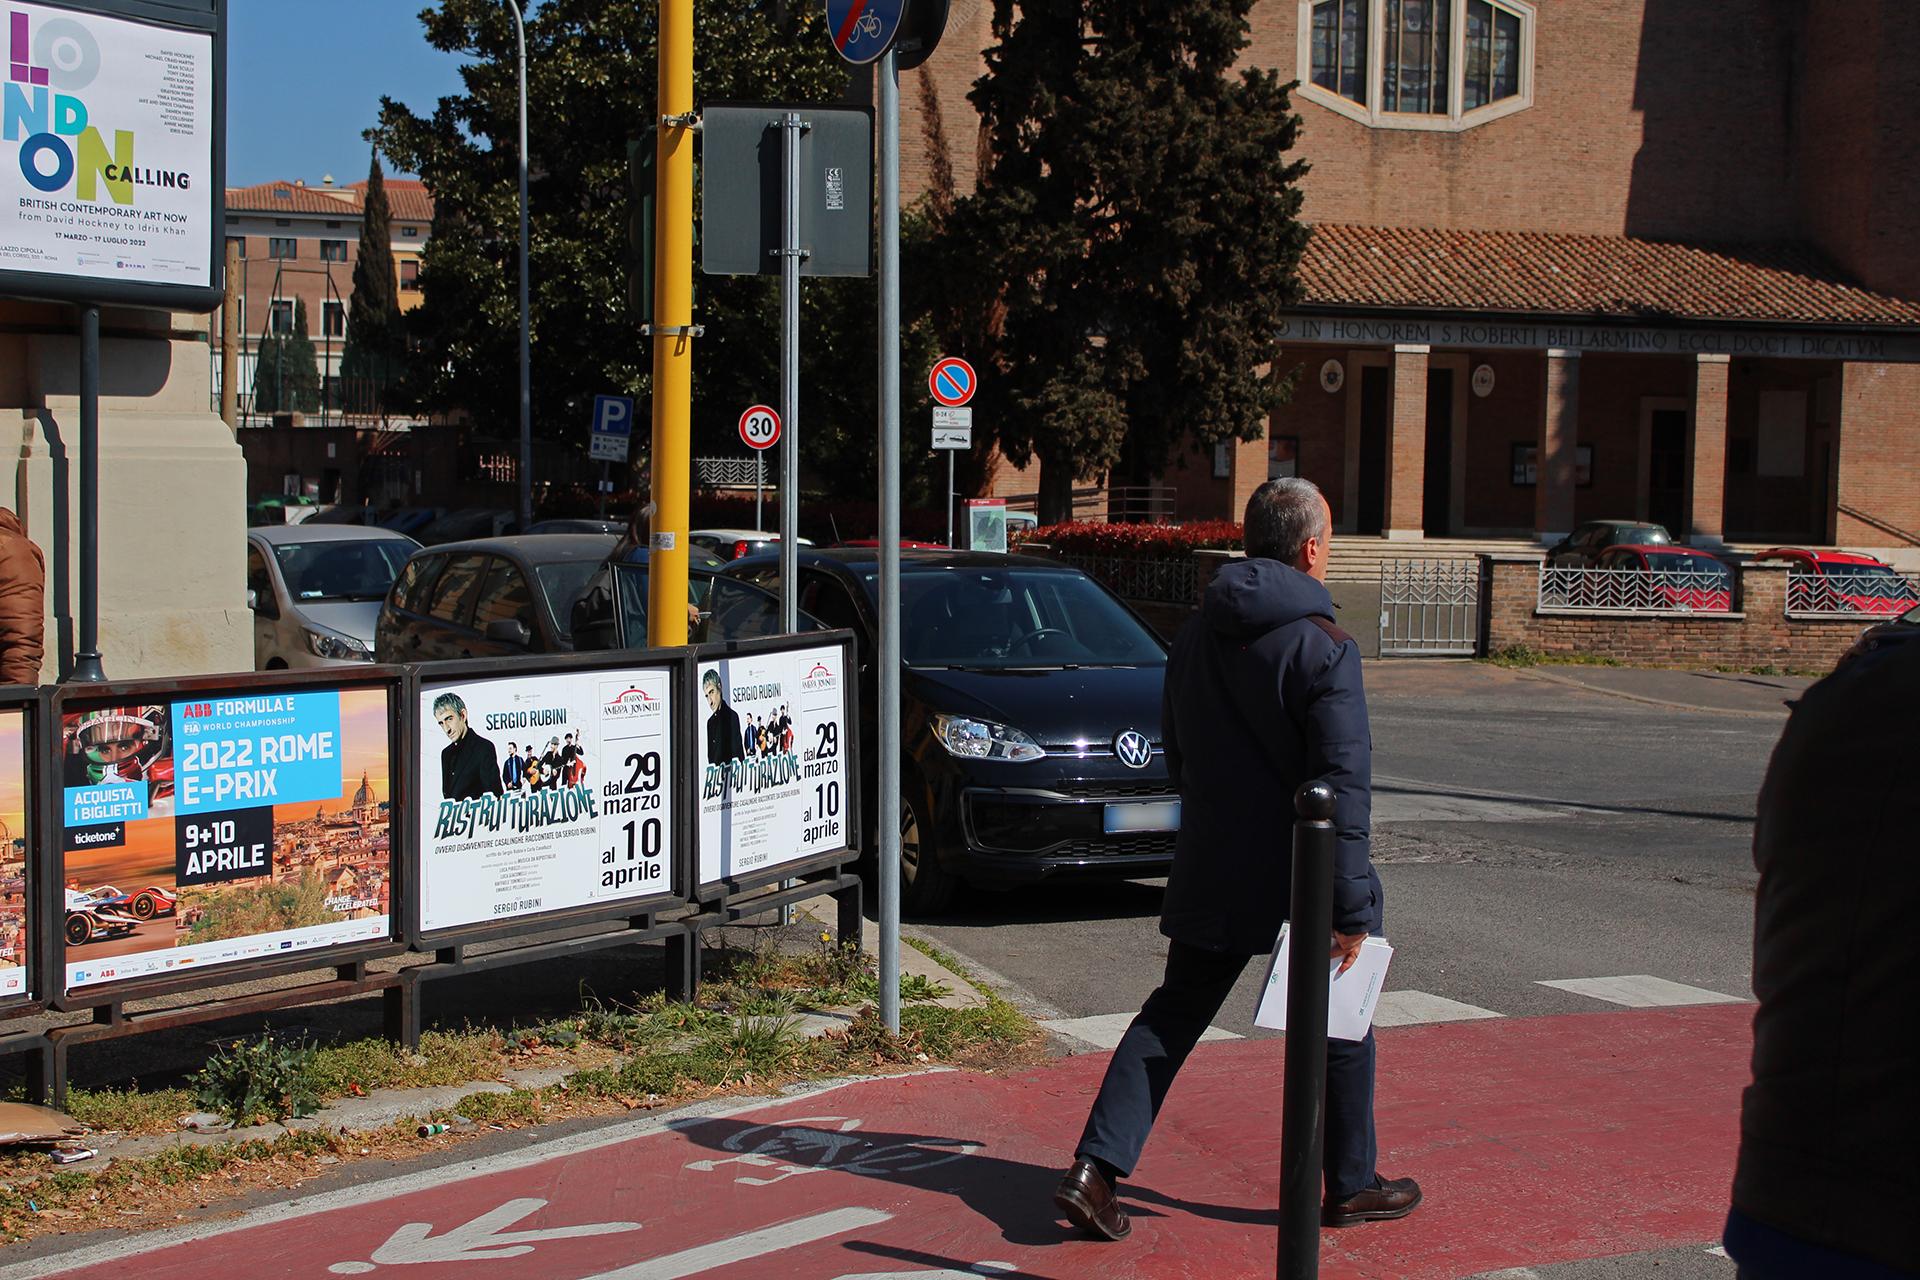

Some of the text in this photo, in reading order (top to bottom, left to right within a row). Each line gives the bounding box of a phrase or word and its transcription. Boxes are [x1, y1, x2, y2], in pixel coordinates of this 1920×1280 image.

[105, 164, 190, 189] CALLING
[20, 198, 187, 223] BRITISH CONTEMPORARY ART NOW
[19, 211, 186, 236] from David Hockney to Idris Khan
[64, 233, 88, 241] MARZO
[103, 237, 128, 245] LUGLIO
[1302, 320, 1322, 338] IN
[1333, 320, 1430, 342] HONOREM
[1460, 324, 1536, 345] ROBERTI
[1548, 328, 1667, 349] BELLARMINO
[1802, 337, 1886, 356] DICATVM
[601, 400, 626, 431] P
[750, 417, 772, 438] 30
[732, 682, 781, 703] SERGIO RUBINI
[183, 697, 295, 719] ABB FORMULA E
[486, 708, 567, 731] SERGIO RUBINI
[203, 722, 232, 731] WORLD
[234, 717, 295, 728] CHAMPIONSHIP
[182, 731, 334, 772] 2022 ROME
[804, 721, 838, 761] dal 29
[603, 752, 661, 797] dal 29
[703, 750, 802, 800] RISTRUTTURAZIONE
[804, 760, 838, 779] marzo
[74, 788, 135, 805] ACQUISTA
[183, 768, 278, 805] E-PRIX
[74, 802, 142, 820] I BIGLIETTI
[434, 783, 598, 840] RISTRUTTURAZIONE
[603, 793, 660, 816] marzo
[803, 807, 811, 822] al
[816, 781, 839, 819] 10
[75, 830, 116, 844] ticketone
[186, 820, 235, 849] 9+10
[435, 826, 596, 855] OVVERO DISAVVENTURE CASALINGHE RACCONTATE DA SERGIO RUBINI
[602, 817, 661, 864] al 10
[803, 821, 839, 844] aprile
[186, 843, 265, 876] APRILE
[602, 861, 661, 888] aprile
[494, 898, 542, 914] SERGIO RUBINI
[100, 969, 115, 978] ABB
